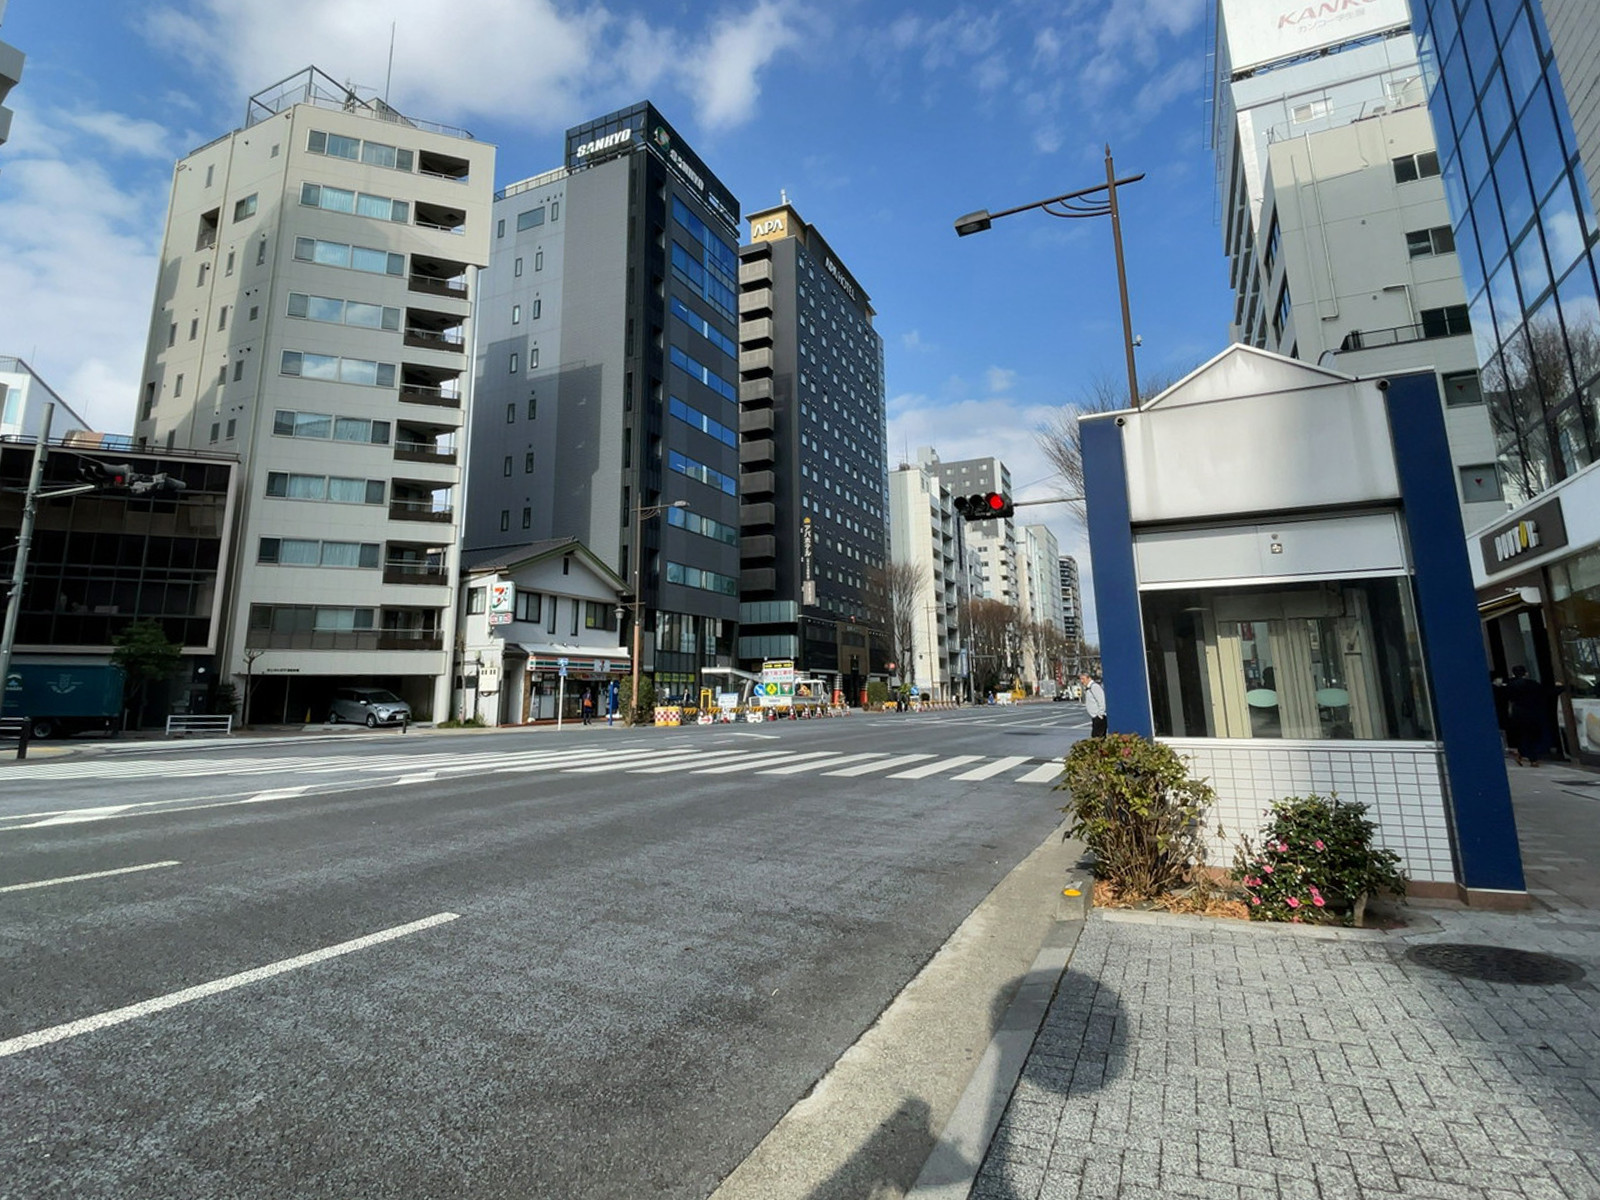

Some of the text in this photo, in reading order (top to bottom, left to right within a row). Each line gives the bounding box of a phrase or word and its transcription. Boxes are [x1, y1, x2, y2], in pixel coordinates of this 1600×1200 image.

[1278, 0, 1376, 29] KANK
[576, 128, 632, 158] SANKYO
[753, 218, 784, 238] APA
[825, 256, 856, 301] APA HOTEL
[803, 524, 813, 558] アパホテル
